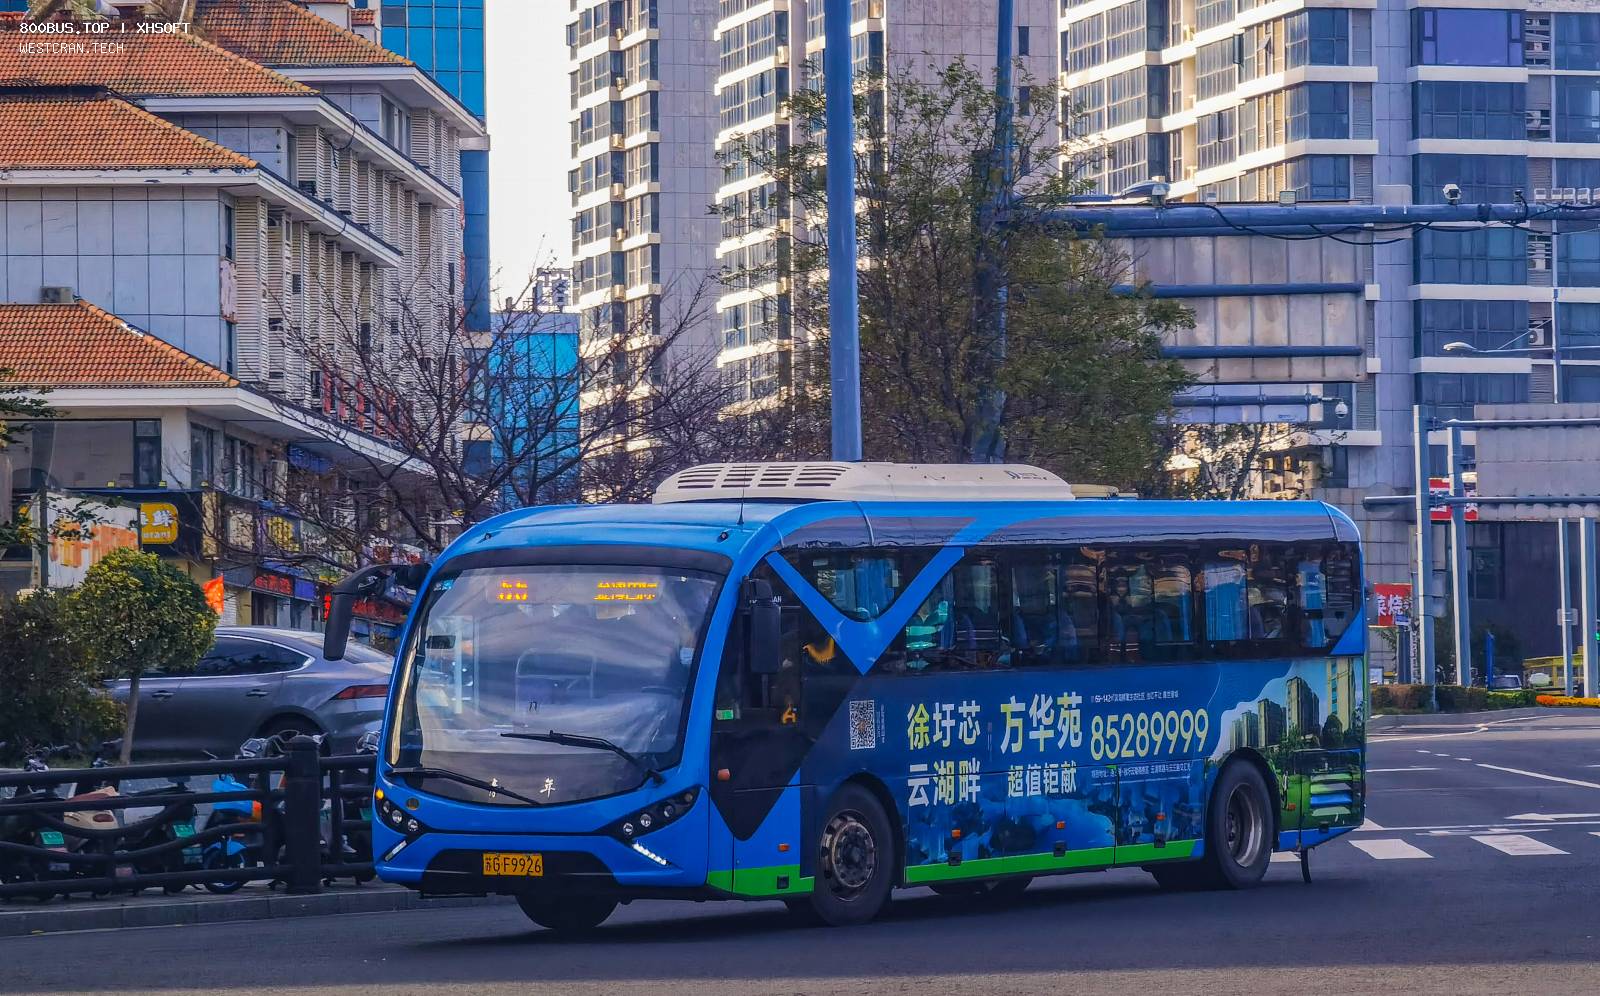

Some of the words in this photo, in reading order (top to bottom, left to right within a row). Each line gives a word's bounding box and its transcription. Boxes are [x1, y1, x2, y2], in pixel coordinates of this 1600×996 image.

[907, 700, 981, 750] 徐圩芯
[1000, 692, 1083, 754] 方华苑
[1090, 708, 1209, 761] 85289999
[907, 757, 981, 807] 云湖畔
